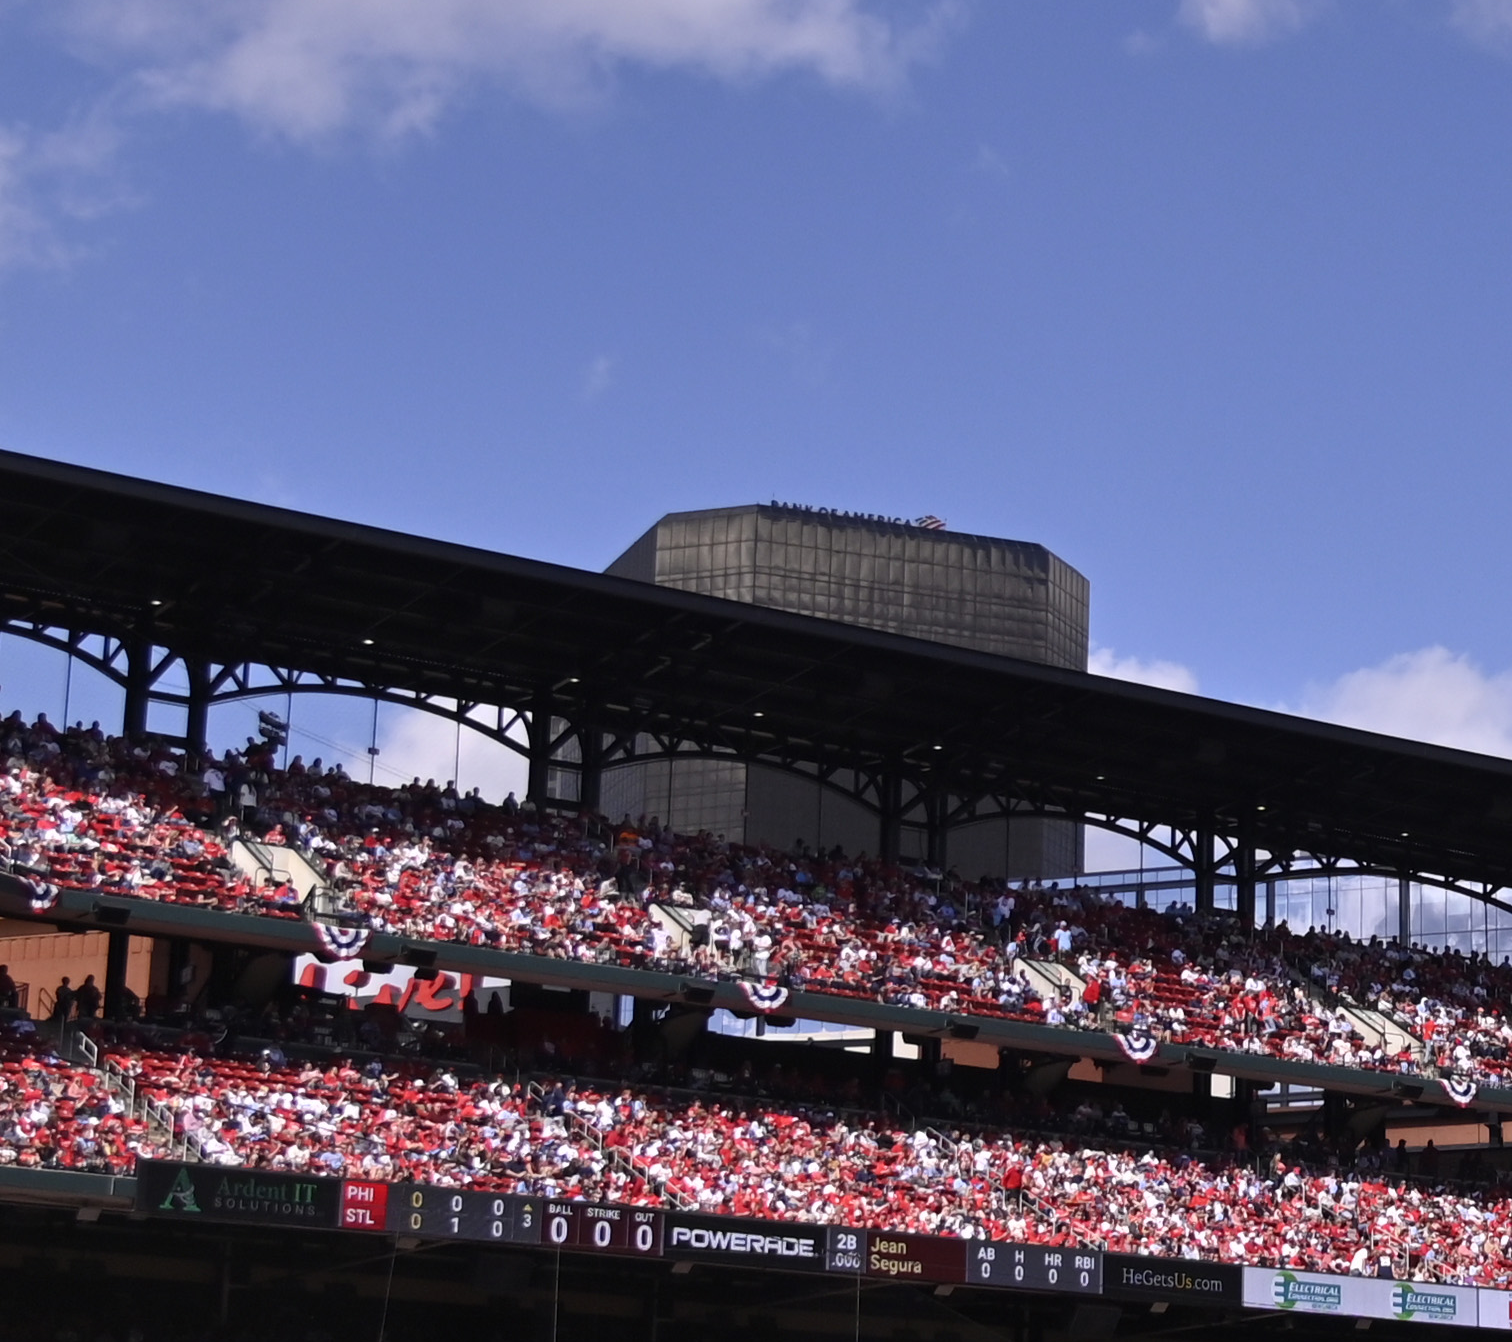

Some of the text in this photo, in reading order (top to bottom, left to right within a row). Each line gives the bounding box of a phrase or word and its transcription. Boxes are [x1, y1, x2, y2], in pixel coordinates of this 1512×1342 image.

[216, 1176, 318, 1203] Ardent IT
[347, 1185, 374, 1203] PHI
[214, 1197, 316, 1216] SOLUTIONS
[345, 1208, 375, 1226] STL
[549, 1203, 655, 1223] BALL STRIKE OUT
[450, 1214, 532, 1234] 1 3
[672, 1227, 816, 1257] POWERADE
[836, 1234, 907, 1255] 2B Jean
[869, 1255, 922, 1276] Segura
[977, 1246, 1095, 1270] AB H HR RBI
[1122, 1267, 1223, 1292] HeGetsUs.com
